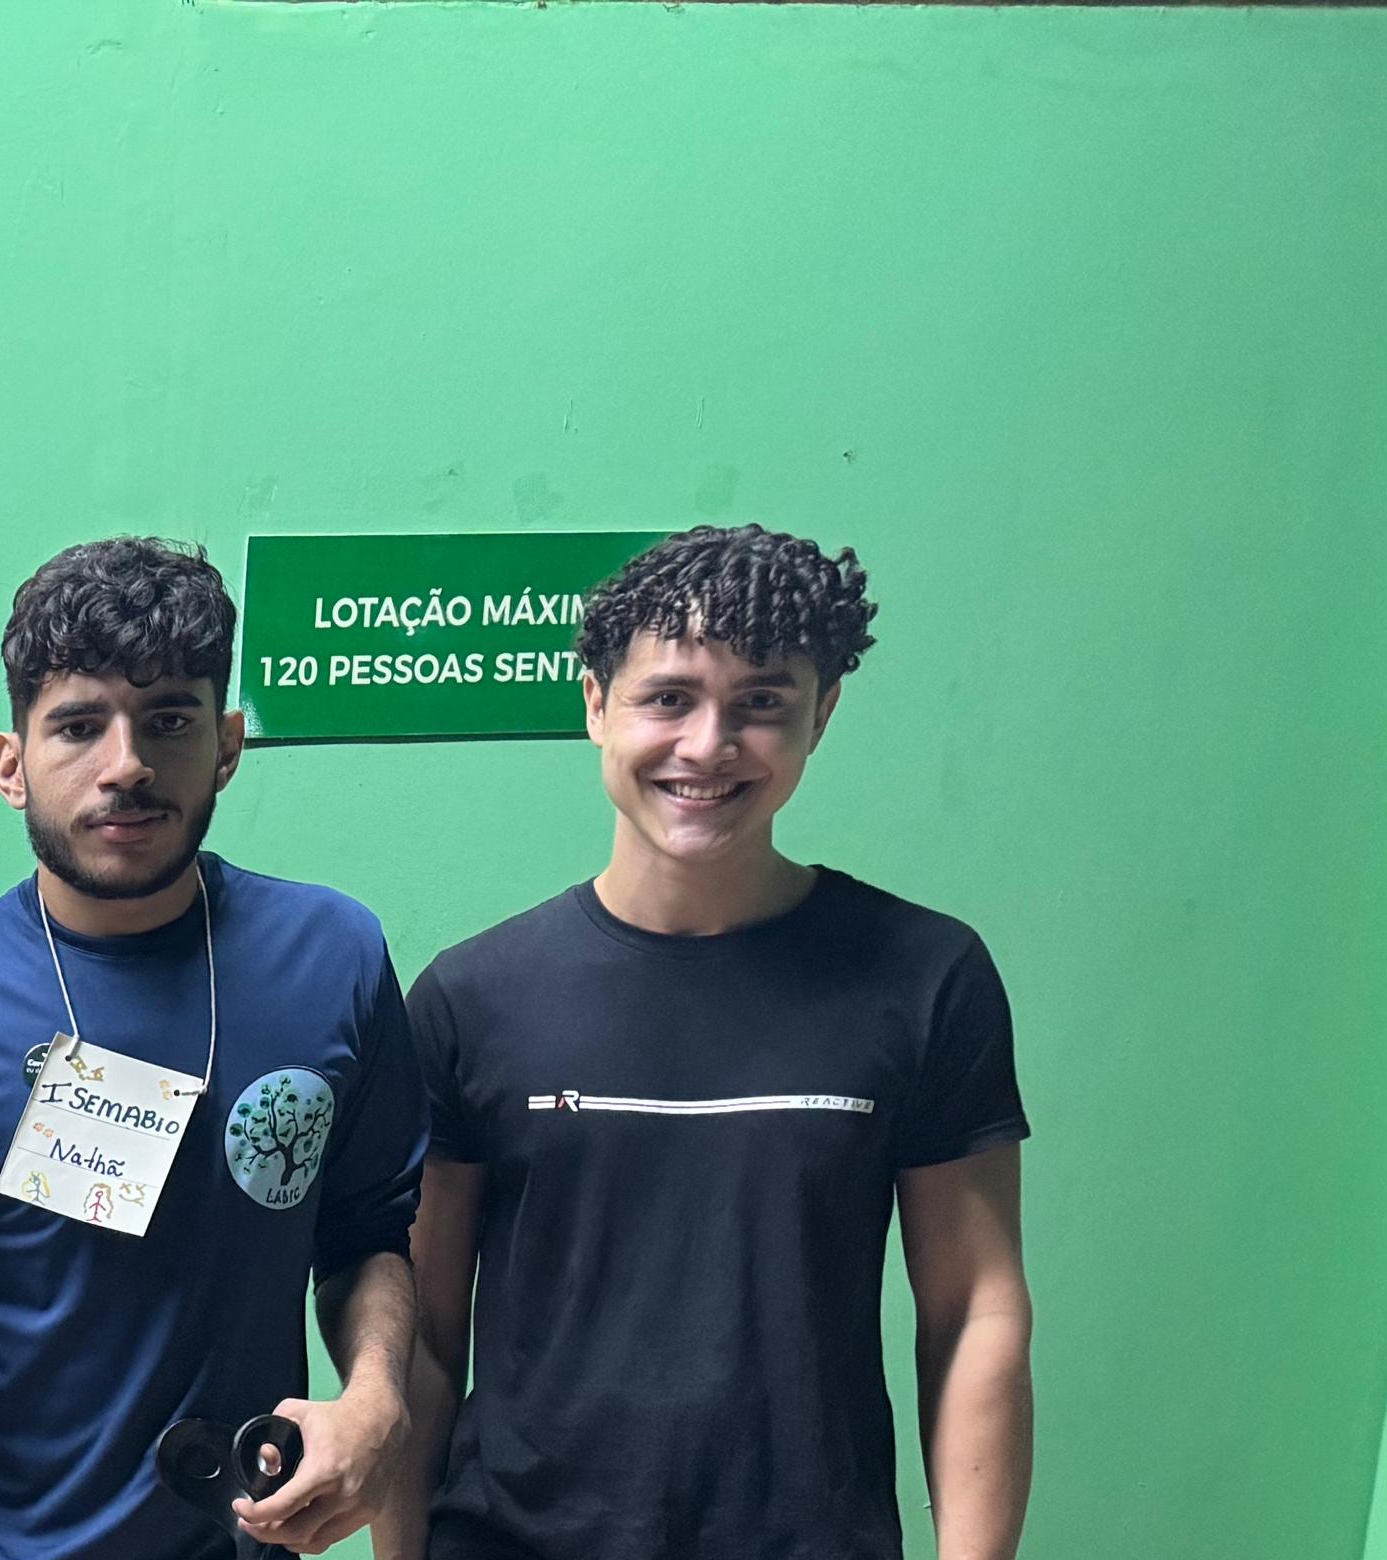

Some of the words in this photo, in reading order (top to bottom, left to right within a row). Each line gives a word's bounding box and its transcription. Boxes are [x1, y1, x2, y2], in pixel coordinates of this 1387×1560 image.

[314, 588, 472, 636] LOTAÇÃO
[260, 655, 319, 687] 120
[329, 653, 484, 685] PESSOAS
[49, 1138, 124, 1178] Nathã
